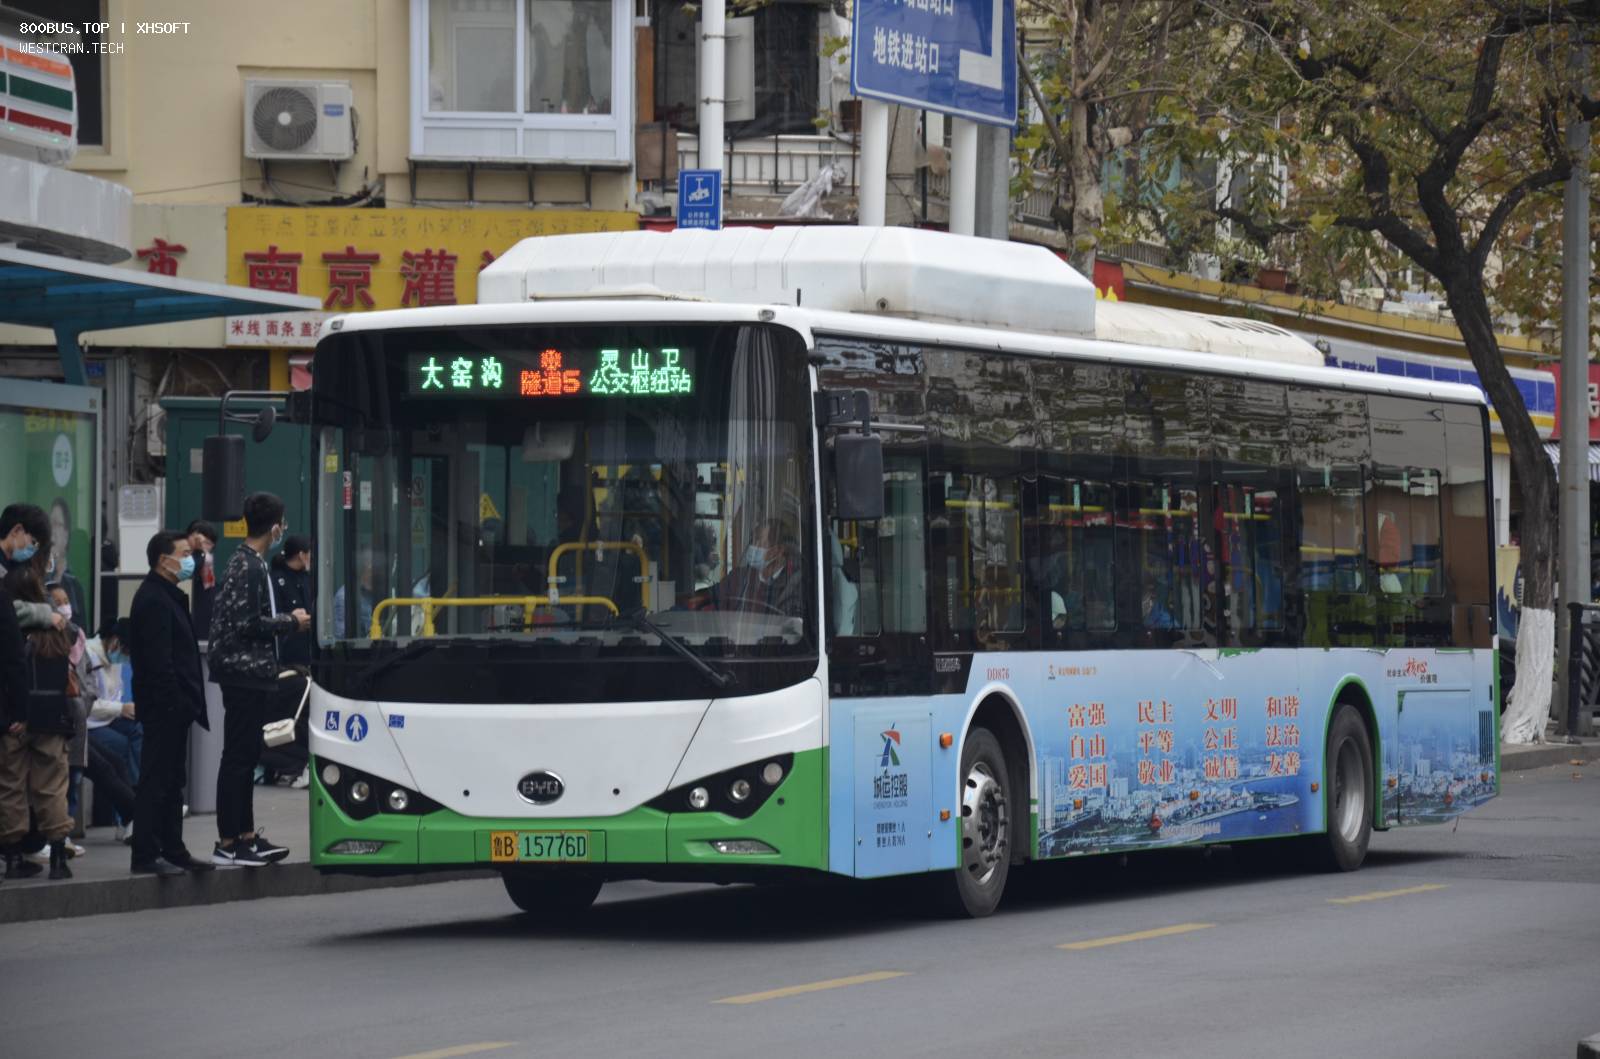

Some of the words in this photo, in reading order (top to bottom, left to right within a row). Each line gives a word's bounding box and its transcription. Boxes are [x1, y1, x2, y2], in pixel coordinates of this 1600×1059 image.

[872, 26, 940, 74] 地铁进站口
[243, 245, 497, 309] 南京灌
[231, 319, 260, 336] 米线
[266, 320, 295, 337] 面条
[420, 356, 502, 390] 大窑沟
[601, 348, 681, 372] 灵山卫
[520, 369, 581, 395] 隧道5
[590, 368, 692, 394] 公交枢纽站
[1067, 703, 1107, 728] 富强
[1137, 700, 1174, 724] 民主
[1203, 698, 1238, 721] 文明
[1266, 695, 1299, 719] 和谐
[1069, 734, 1106, 760] 自由
[1139, 729, 1173, 754] 平等
[1203, 727, 1239, 751] 公正
[1265, 724, 1300, 747] 法治
[1068, 763, 1108, 791] 爱国
[1138, 759, 1174, 785] 敬业
[1204, 756, 1239, 780] 诚信
[1266, 752, 1300, 777] 友善
[522, 780, 560, 795] BYD
[524, 836, 587, 858] 15776D
